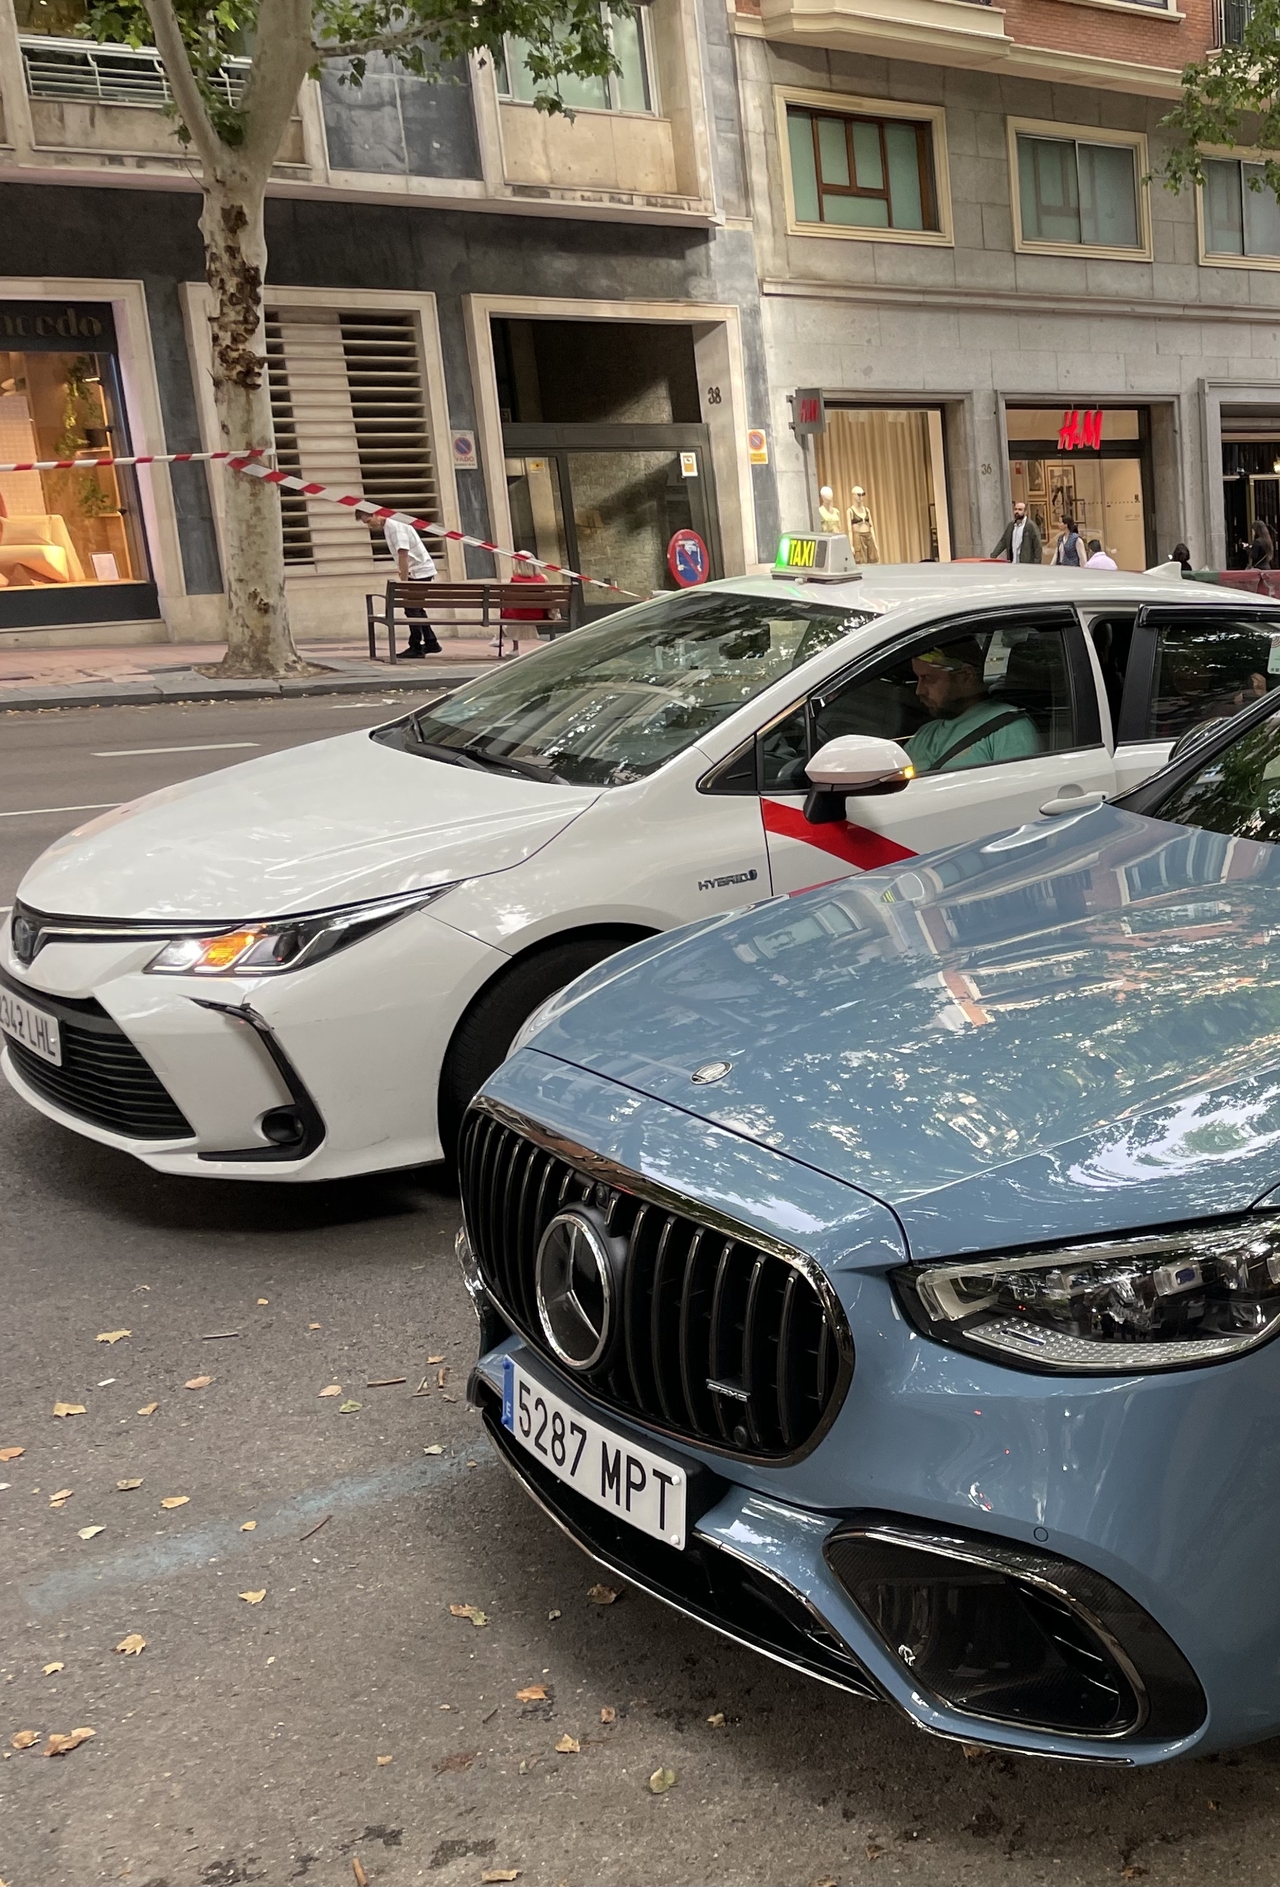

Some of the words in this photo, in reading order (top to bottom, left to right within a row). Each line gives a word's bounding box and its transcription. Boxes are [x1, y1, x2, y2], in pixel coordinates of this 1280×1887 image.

[708, 386, 722, 405] 38
[1057, 410, 1103, 450] H&M
[981, 463, 992, 475] 36
[789, 538, 816, 567] TAXI
[698, 873, 749, 891] HYBRID
[0, 994, 26, 1040] 342
[26, 1009, 56, 1057] LHL
[506, 1401, 512, 1418] E
[519, 1380, 587, 1477] 5287
[601, 1440, 674, 1531] MPT
